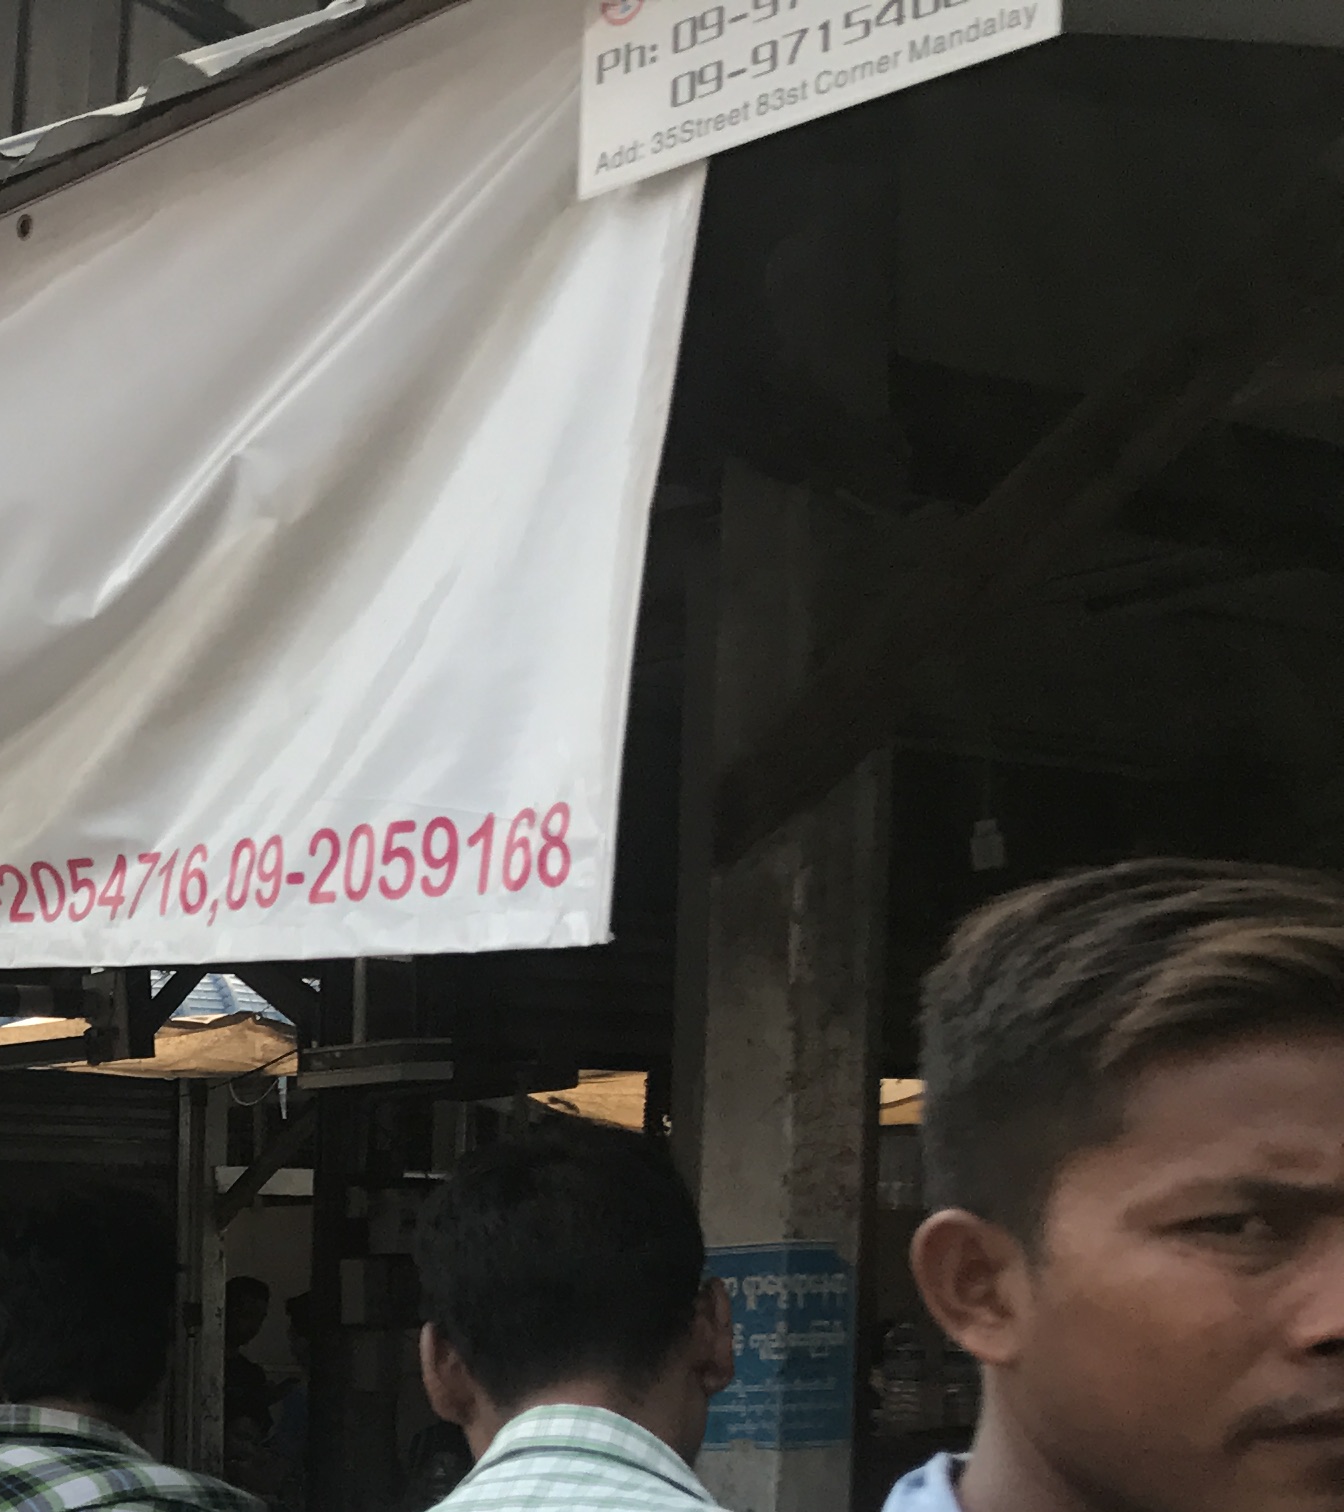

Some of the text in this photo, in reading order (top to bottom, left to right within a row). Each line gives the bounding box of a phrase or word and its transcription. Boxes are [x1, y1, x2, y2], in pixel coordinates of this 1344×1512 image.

[595, 3, 1038, 175] Add: 35Street 83st Corner Mandalay
[596, 42, 659, 84] Ph:
